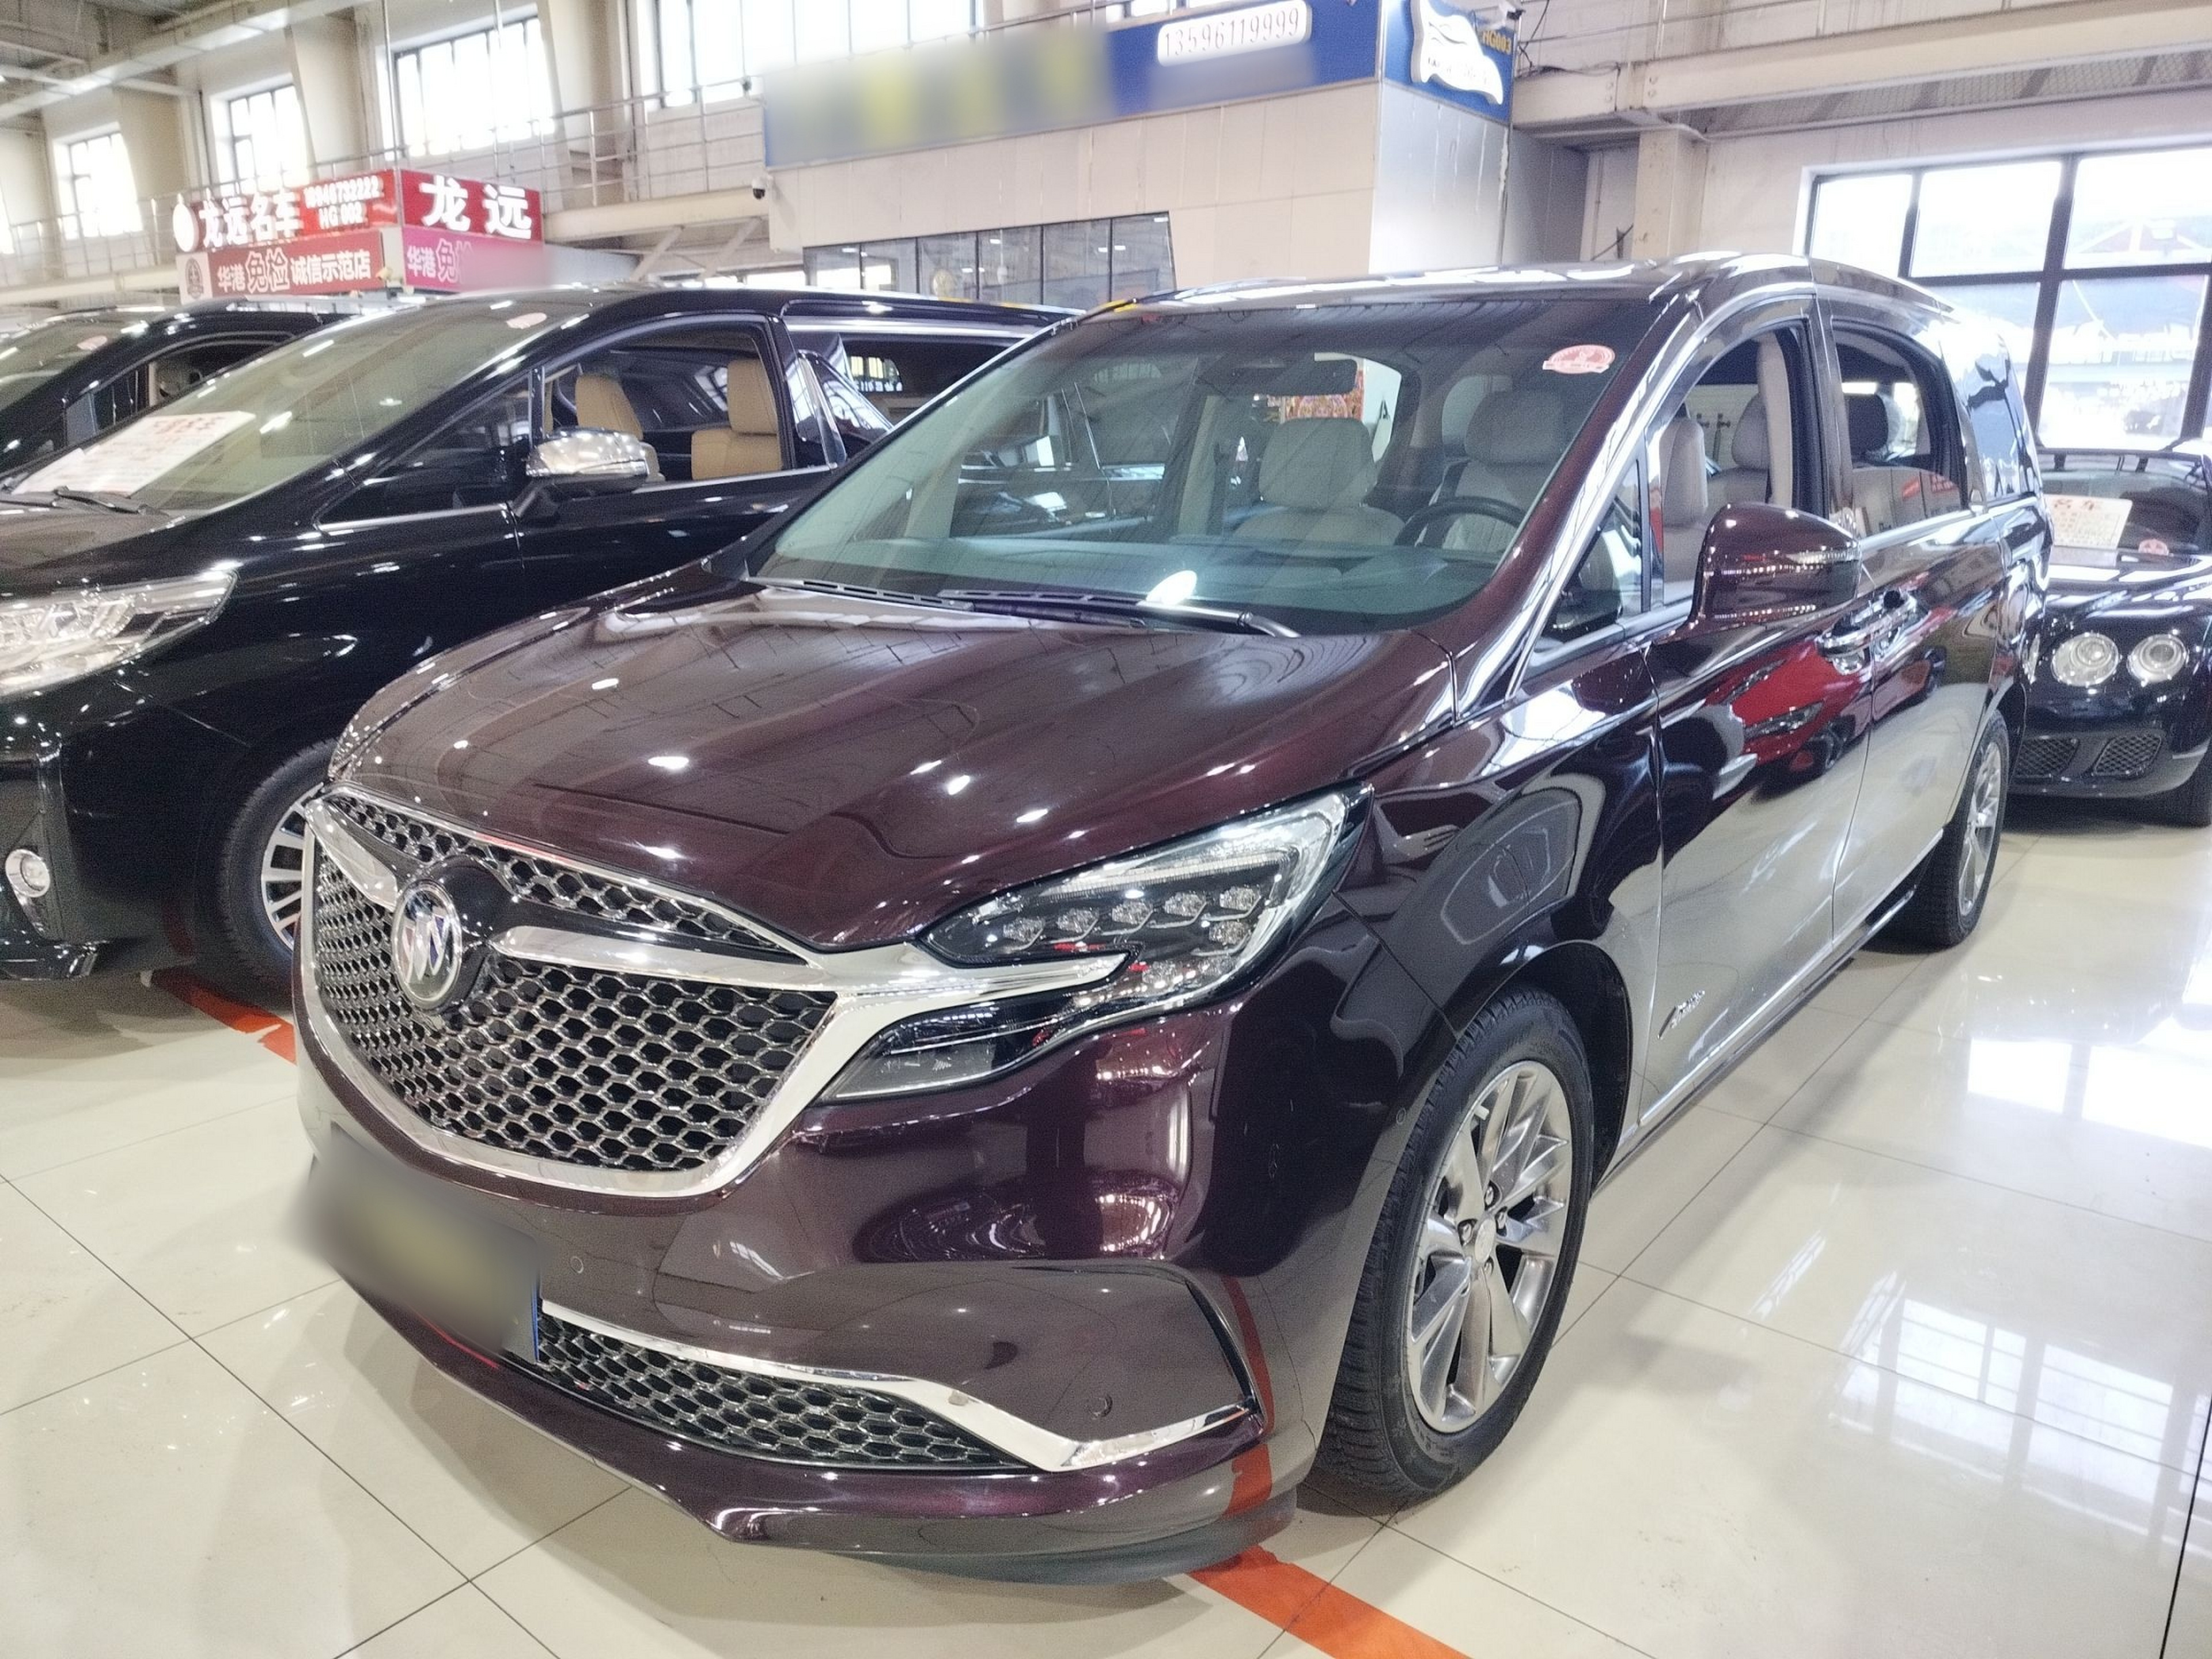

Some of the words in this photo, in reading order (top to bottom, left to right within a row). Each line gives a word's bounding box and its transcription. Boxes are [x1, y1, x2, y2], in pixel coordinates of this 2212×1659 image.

[1164, 7, 1300, 57] 13596119999
[199, 189, 304, 248] 龙远名车
[419, 175, 532, 240] 龙远
